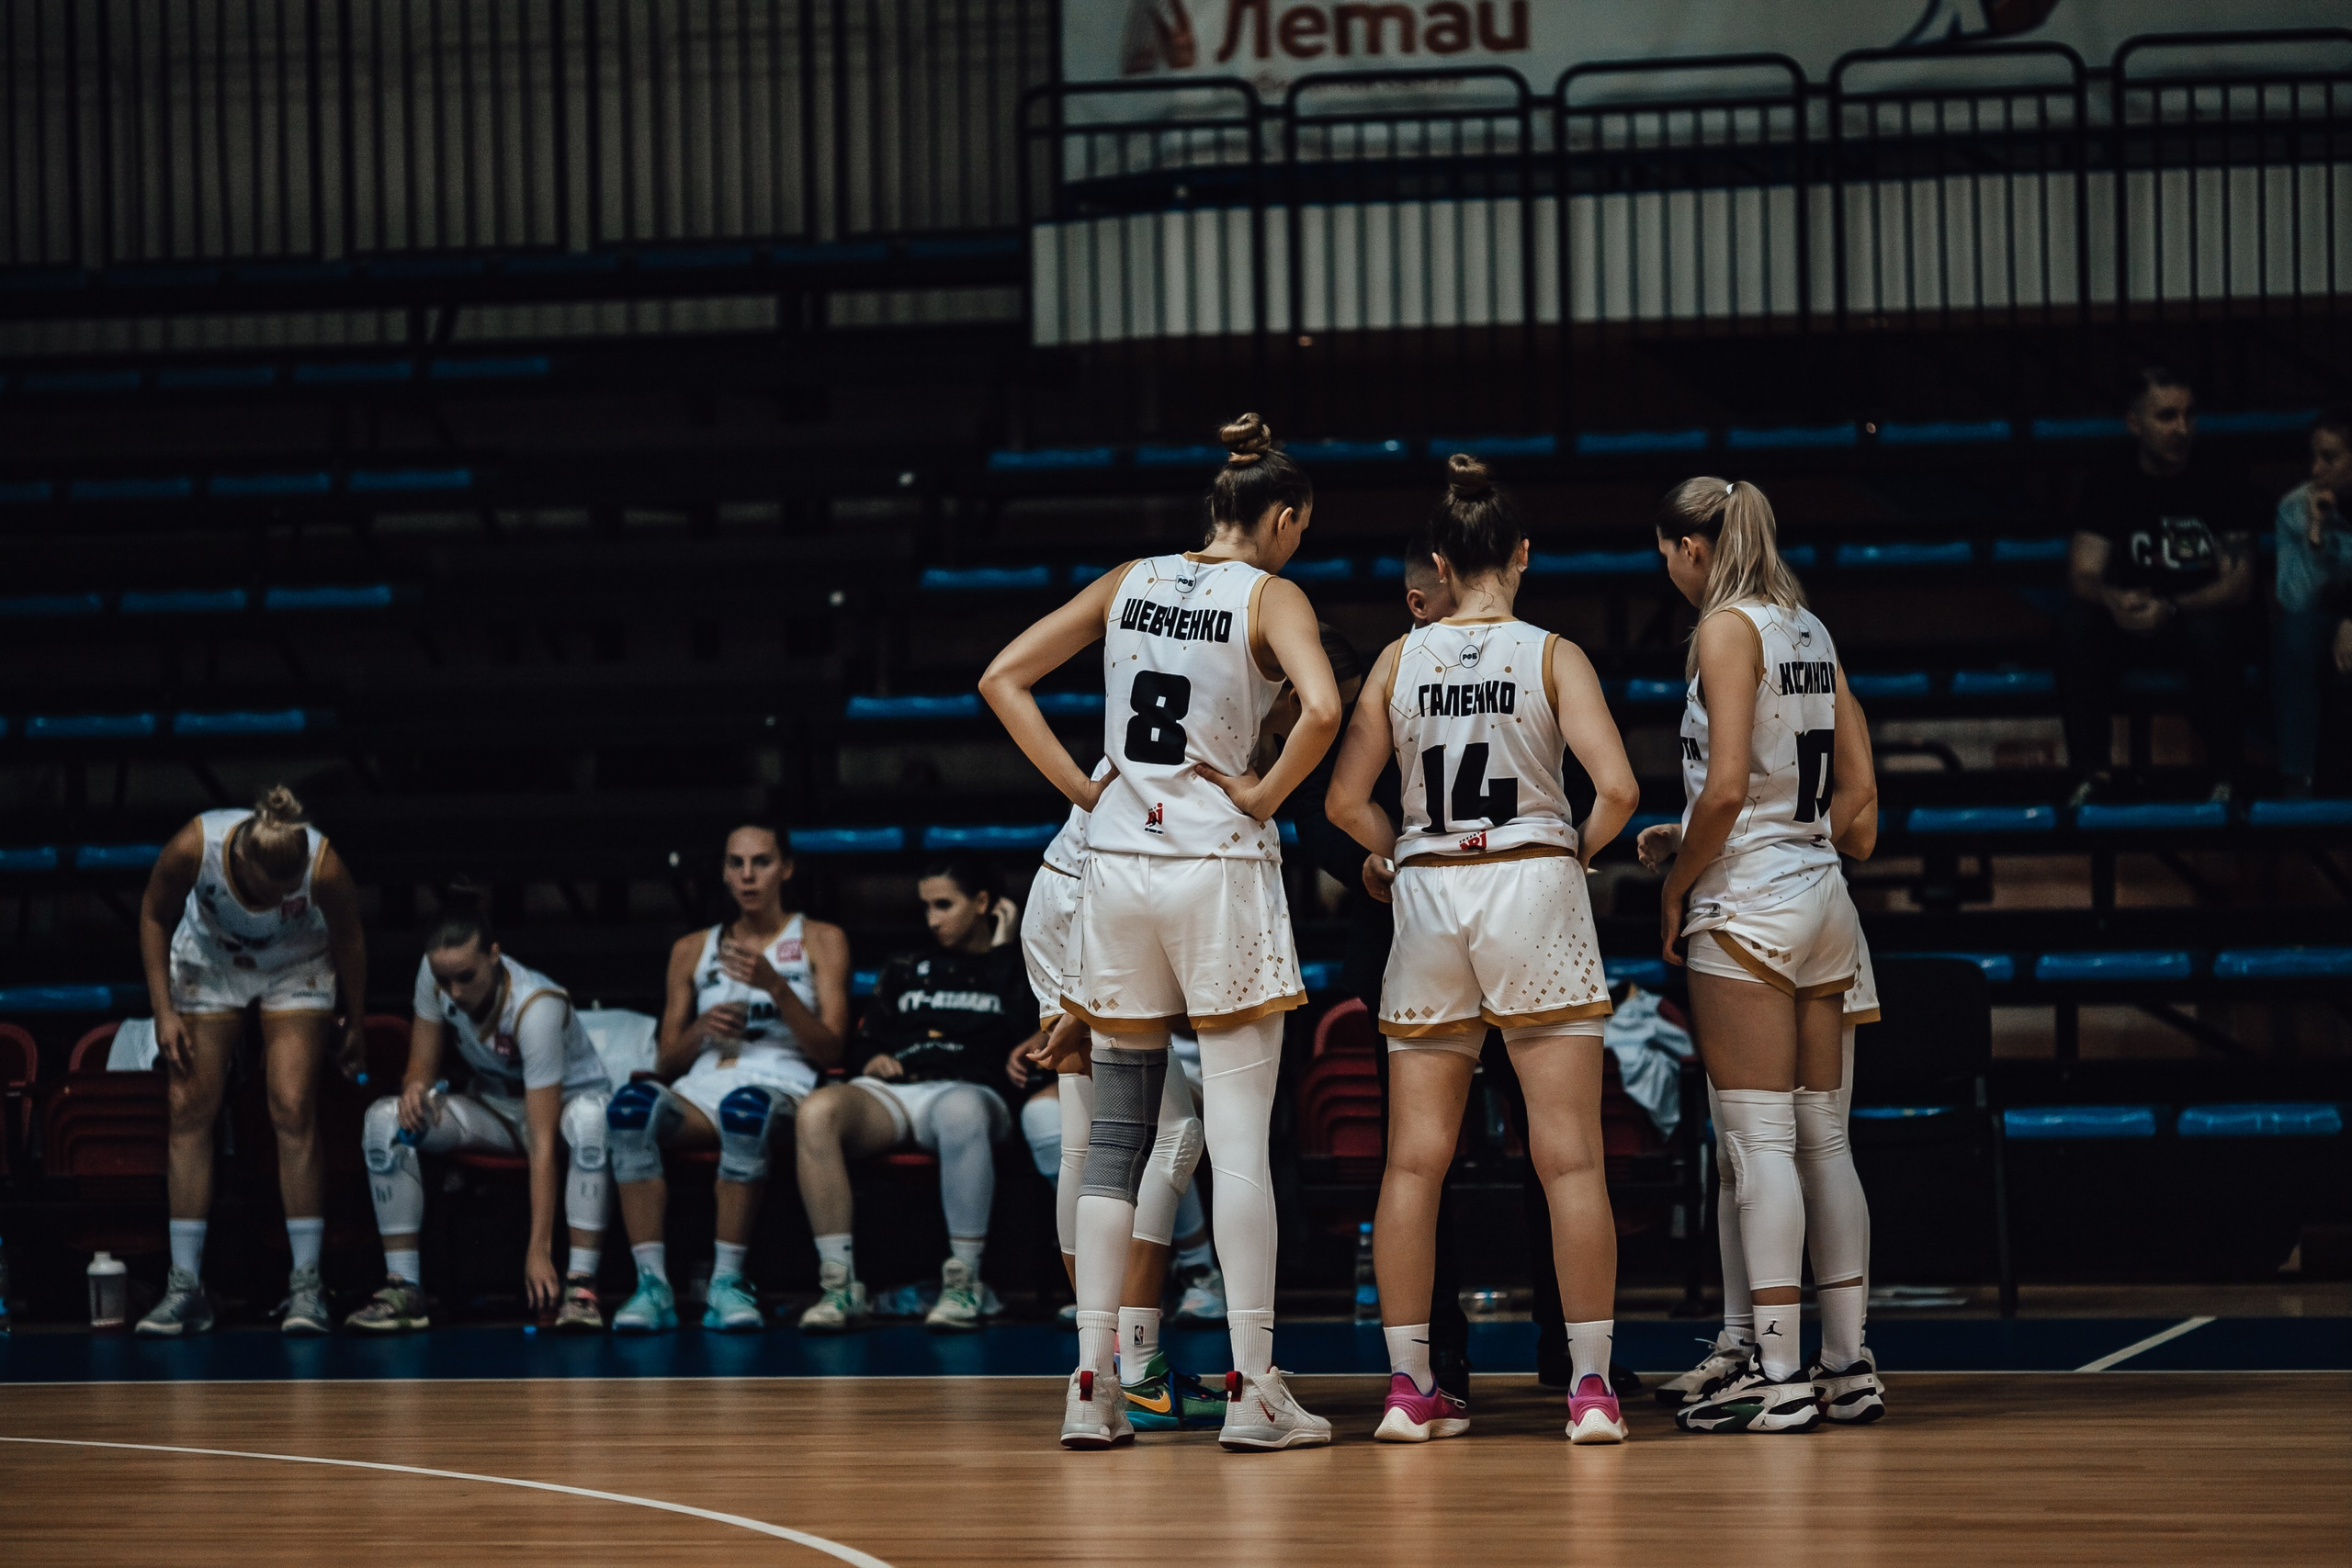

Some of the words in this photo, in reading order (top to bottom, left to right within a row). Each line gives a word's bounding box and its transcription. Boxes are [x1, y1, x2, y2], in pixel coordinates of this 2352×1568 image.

[1119, 598, 1233, 643] ШЕВЧЕНКО
[1124, 671, 1192, 765] 8
[1418, 680, 1517, 718] ГАЛЕНКО
[1421, 742, 1519, 833] 14
